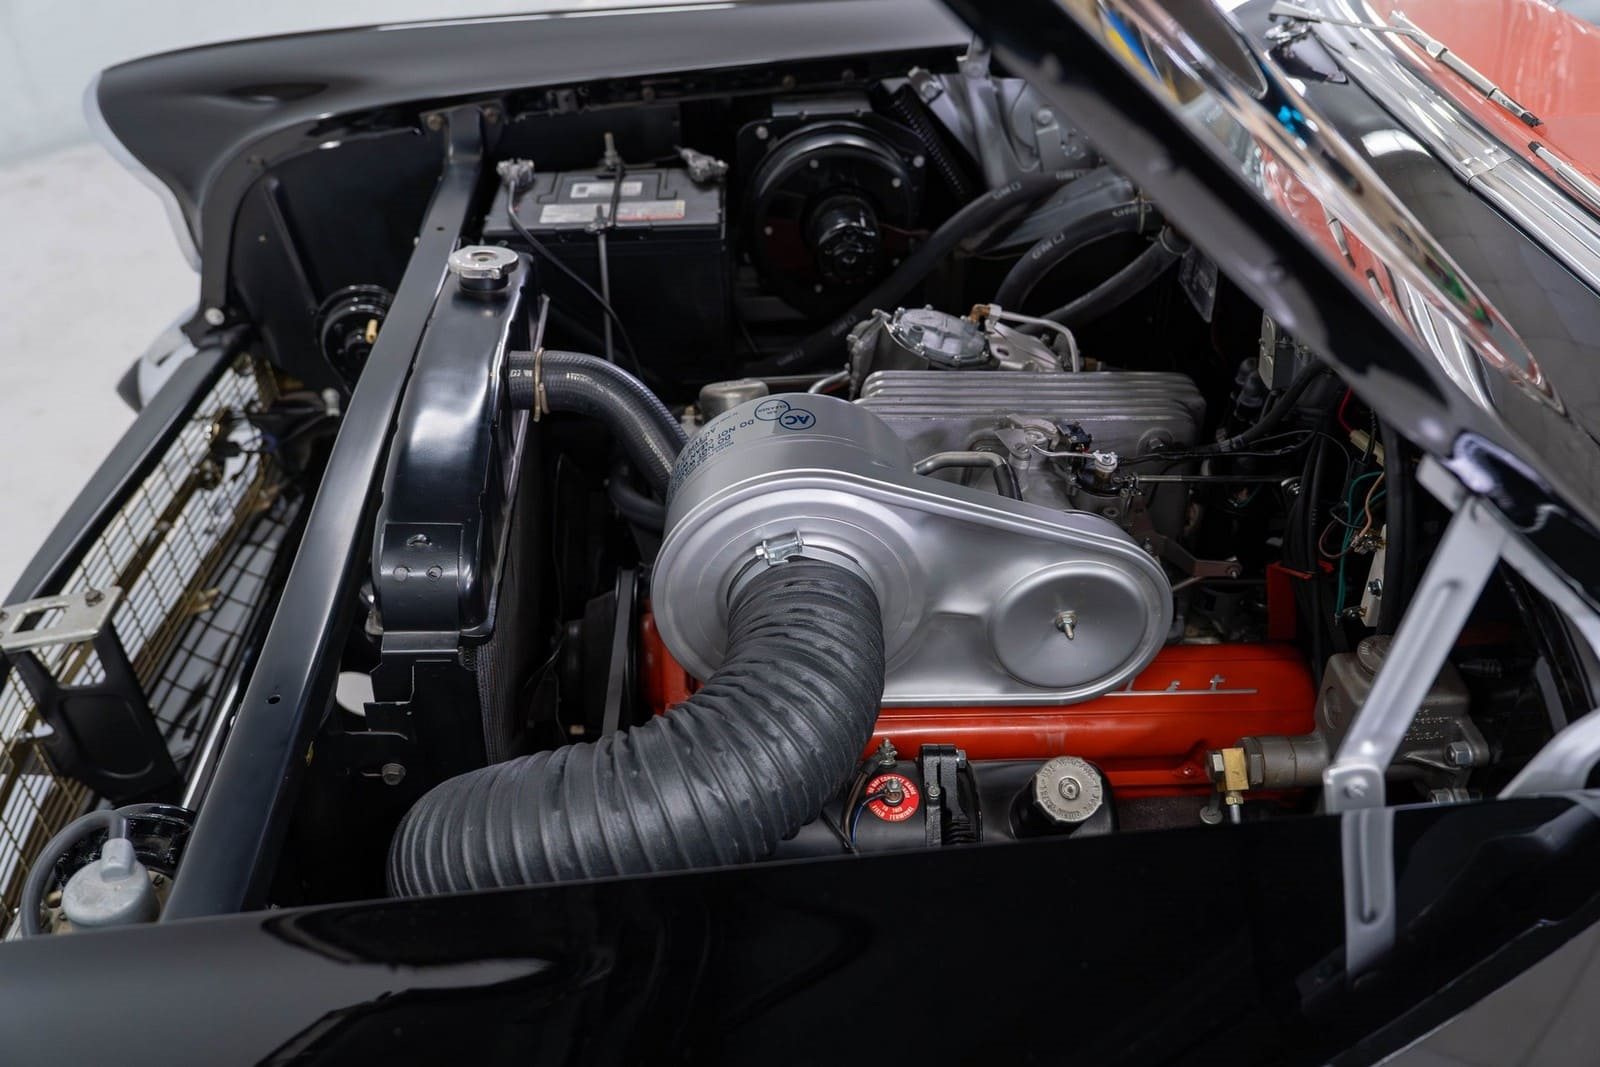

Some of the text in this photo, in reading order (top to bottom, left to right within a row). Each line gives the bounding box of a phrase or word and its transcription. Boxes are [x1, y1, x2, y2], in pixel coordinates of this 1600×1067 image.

[1031, 239, 1054, 260] GM
[758, 405, 787, 413] CLEANER
[738, 418, 755, 429] DO
[784, 415, 810, 425] AC
[716, 425, 737, 439] NOT
[716, 433, 732, 445] DO
[697, 443, 715, 459] NOT
[889, 805, 914, 821] TERMINAL
